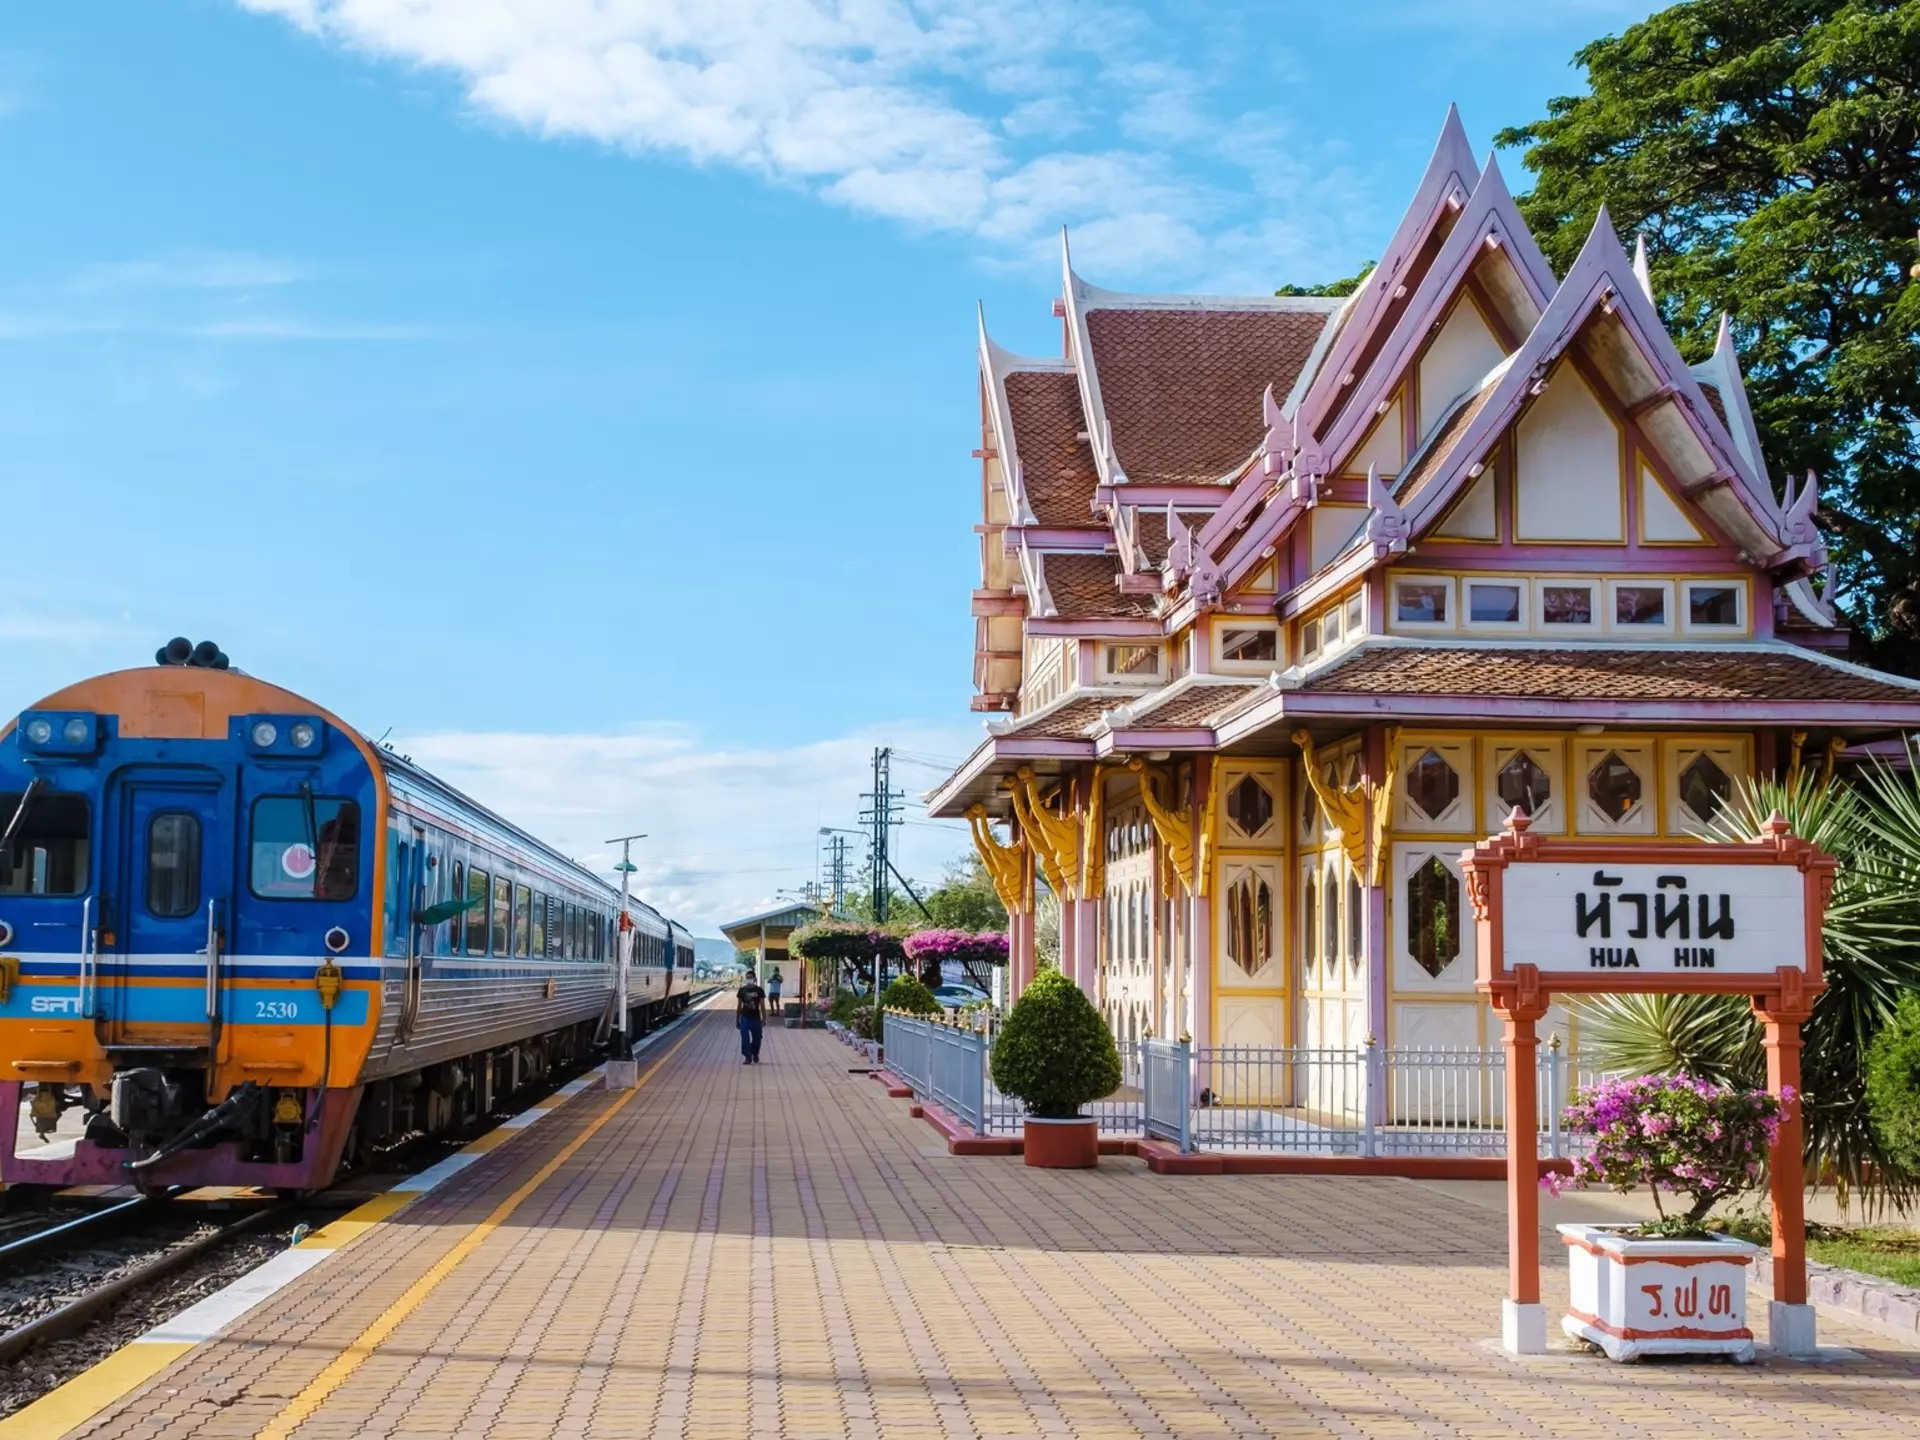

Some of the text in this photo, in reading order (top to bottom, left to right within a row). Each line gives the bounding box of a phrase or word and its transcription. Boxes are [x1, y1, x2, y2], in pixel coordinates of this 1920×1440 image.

[1575, 870, 1735, 940] หัวหิน
[1590, 947, 1716, 968] HUA HIN
[255, 1001, 298, 1019] 2530
